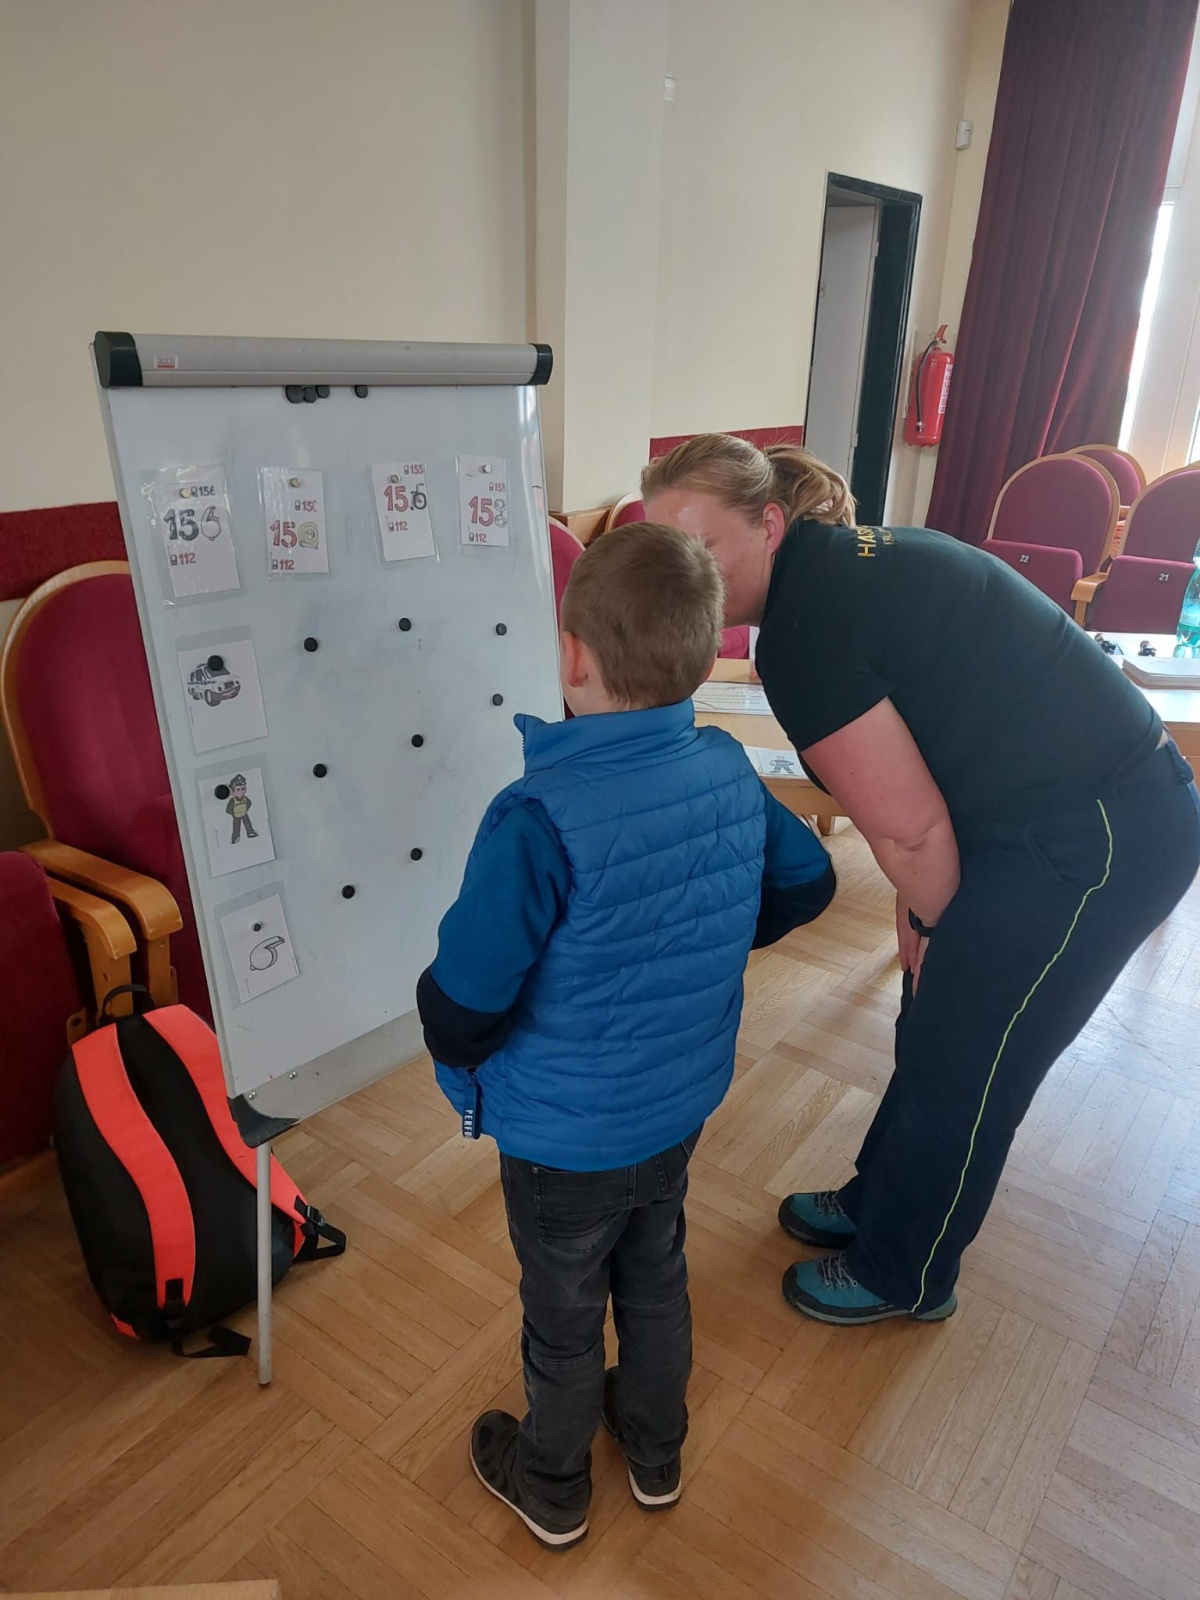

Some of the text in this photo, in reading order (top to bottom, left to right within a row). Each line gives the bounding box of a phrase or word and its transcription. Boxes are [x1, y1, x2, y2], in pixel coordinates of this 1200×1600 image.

[394, 520, 408, 532] 112
[475, 532, 487, 543] 112
[179, 552, 197, 565] 112
[1019, 554, 1030, 563] 22
[279, 559, 295, 570] 112
[1158, 573, 1169, 582] 21
